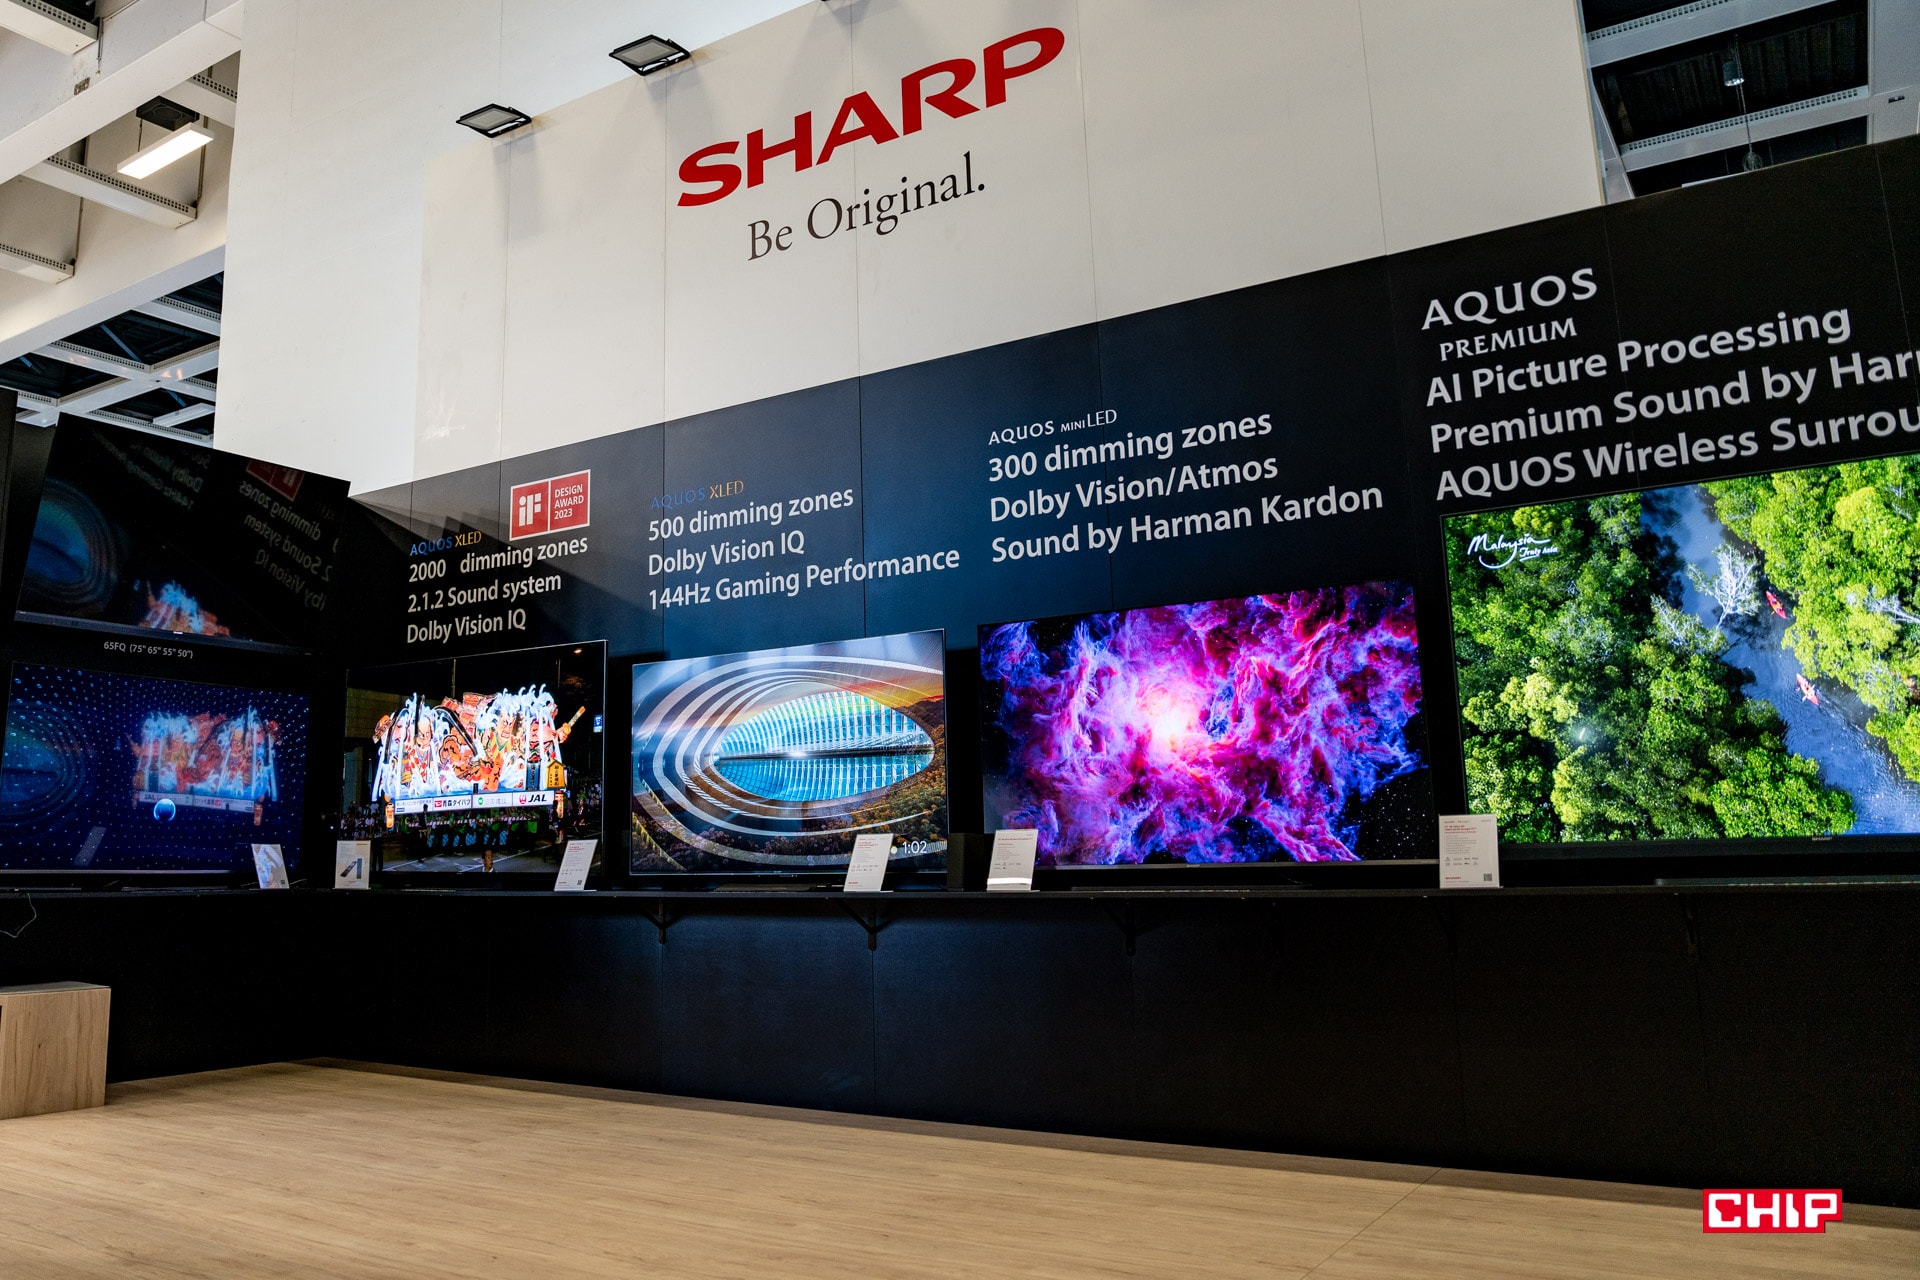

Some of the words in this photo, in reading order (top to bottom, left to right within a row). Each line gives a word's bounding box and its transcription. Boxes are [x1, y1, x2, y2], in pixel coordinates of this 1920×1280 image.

[677, 27, 1065, 207] SHARP
[747, 219, 793, 261] Be
[807, 150, 986, 240] Original.
[1421, 267, 1598, 330] AQUOS
[1426, 373, 1462, 407] AI
[1472, 352, 1608, 399] Picture
[1617, 308, 1852, 373] Processing
[1439, 317, 1577, 362] PREMIUM
[1430, 404, 1602, 454] Premium
[1613, 370, 1751, 423] Sound
[1762, 364, 1817, 404] by
[1829, 349, 1920, 389] Har
[988, 421, 1055, 445] AQUOS
[988, 451, 1037, 482] 300
[1044, 431, 1174, 474] dimming
[1181, 413, 1273, 449] zones
[1436, 451, 1576, 501] AQUOS
[1582, 431, 1759, 480] Wireless
[554, 484, 583, 499] DESIGN
[554, 495, 585, 509] AWARD
[650, 487, 705, 510] AQUOS
[708, 480, 745, 499] XLED
[990, 489, 1070, 522] Dolby
[1075, 457, 1279, 508] Vision/Atmos
[554, 508, 573, 520] 2023
[648, 515, 684, 541] 500
[689, 501, 783, 534] dimming
[788, 488, 854, 517] zones
[991, 524, 1080, 563] Sound
[1088, 522, 1123, 554] by
[1130, 505, 1253, 543] Harman
[1261, 485, 1383, 524] Kardon
[408, 558, 447, 583] 2000
[459, 545, 534, 574] dimming
[537, 537, 588, 561] zones
[409, 536, 453, 557] AQUOS
[454, 530, 482, 548] XLED
[648, 547, 707, 576] Dolby
[710, 538, 774, 566] Vision
[781, 530, 805, 555] IQ
[1467, 533, 1551, 569] Malaysia
[1519, 547, 1541, 559] Truly
[408, 589, 444, 613] 2.1.2
[447, 578, 499, 607] Sound
[502, 573, 562, 603] system
[649, 582, 711, 610] 144Hz
[715, 571, 800, 602] Gaming
[805, 549, 960, 588] Performance
[103, 641, 126, 652] 65FQ
[147, 646, 162, 655] 65"
[162, 647, 177, 656] 55"
[407, 619, 452, 644] Dolby
[455, 613, 503, 637] Vision
[508, 608, 527, 631] IQ
[528, 793, 548, 803] JAL
[902, 840, 928, 854] 1:02
